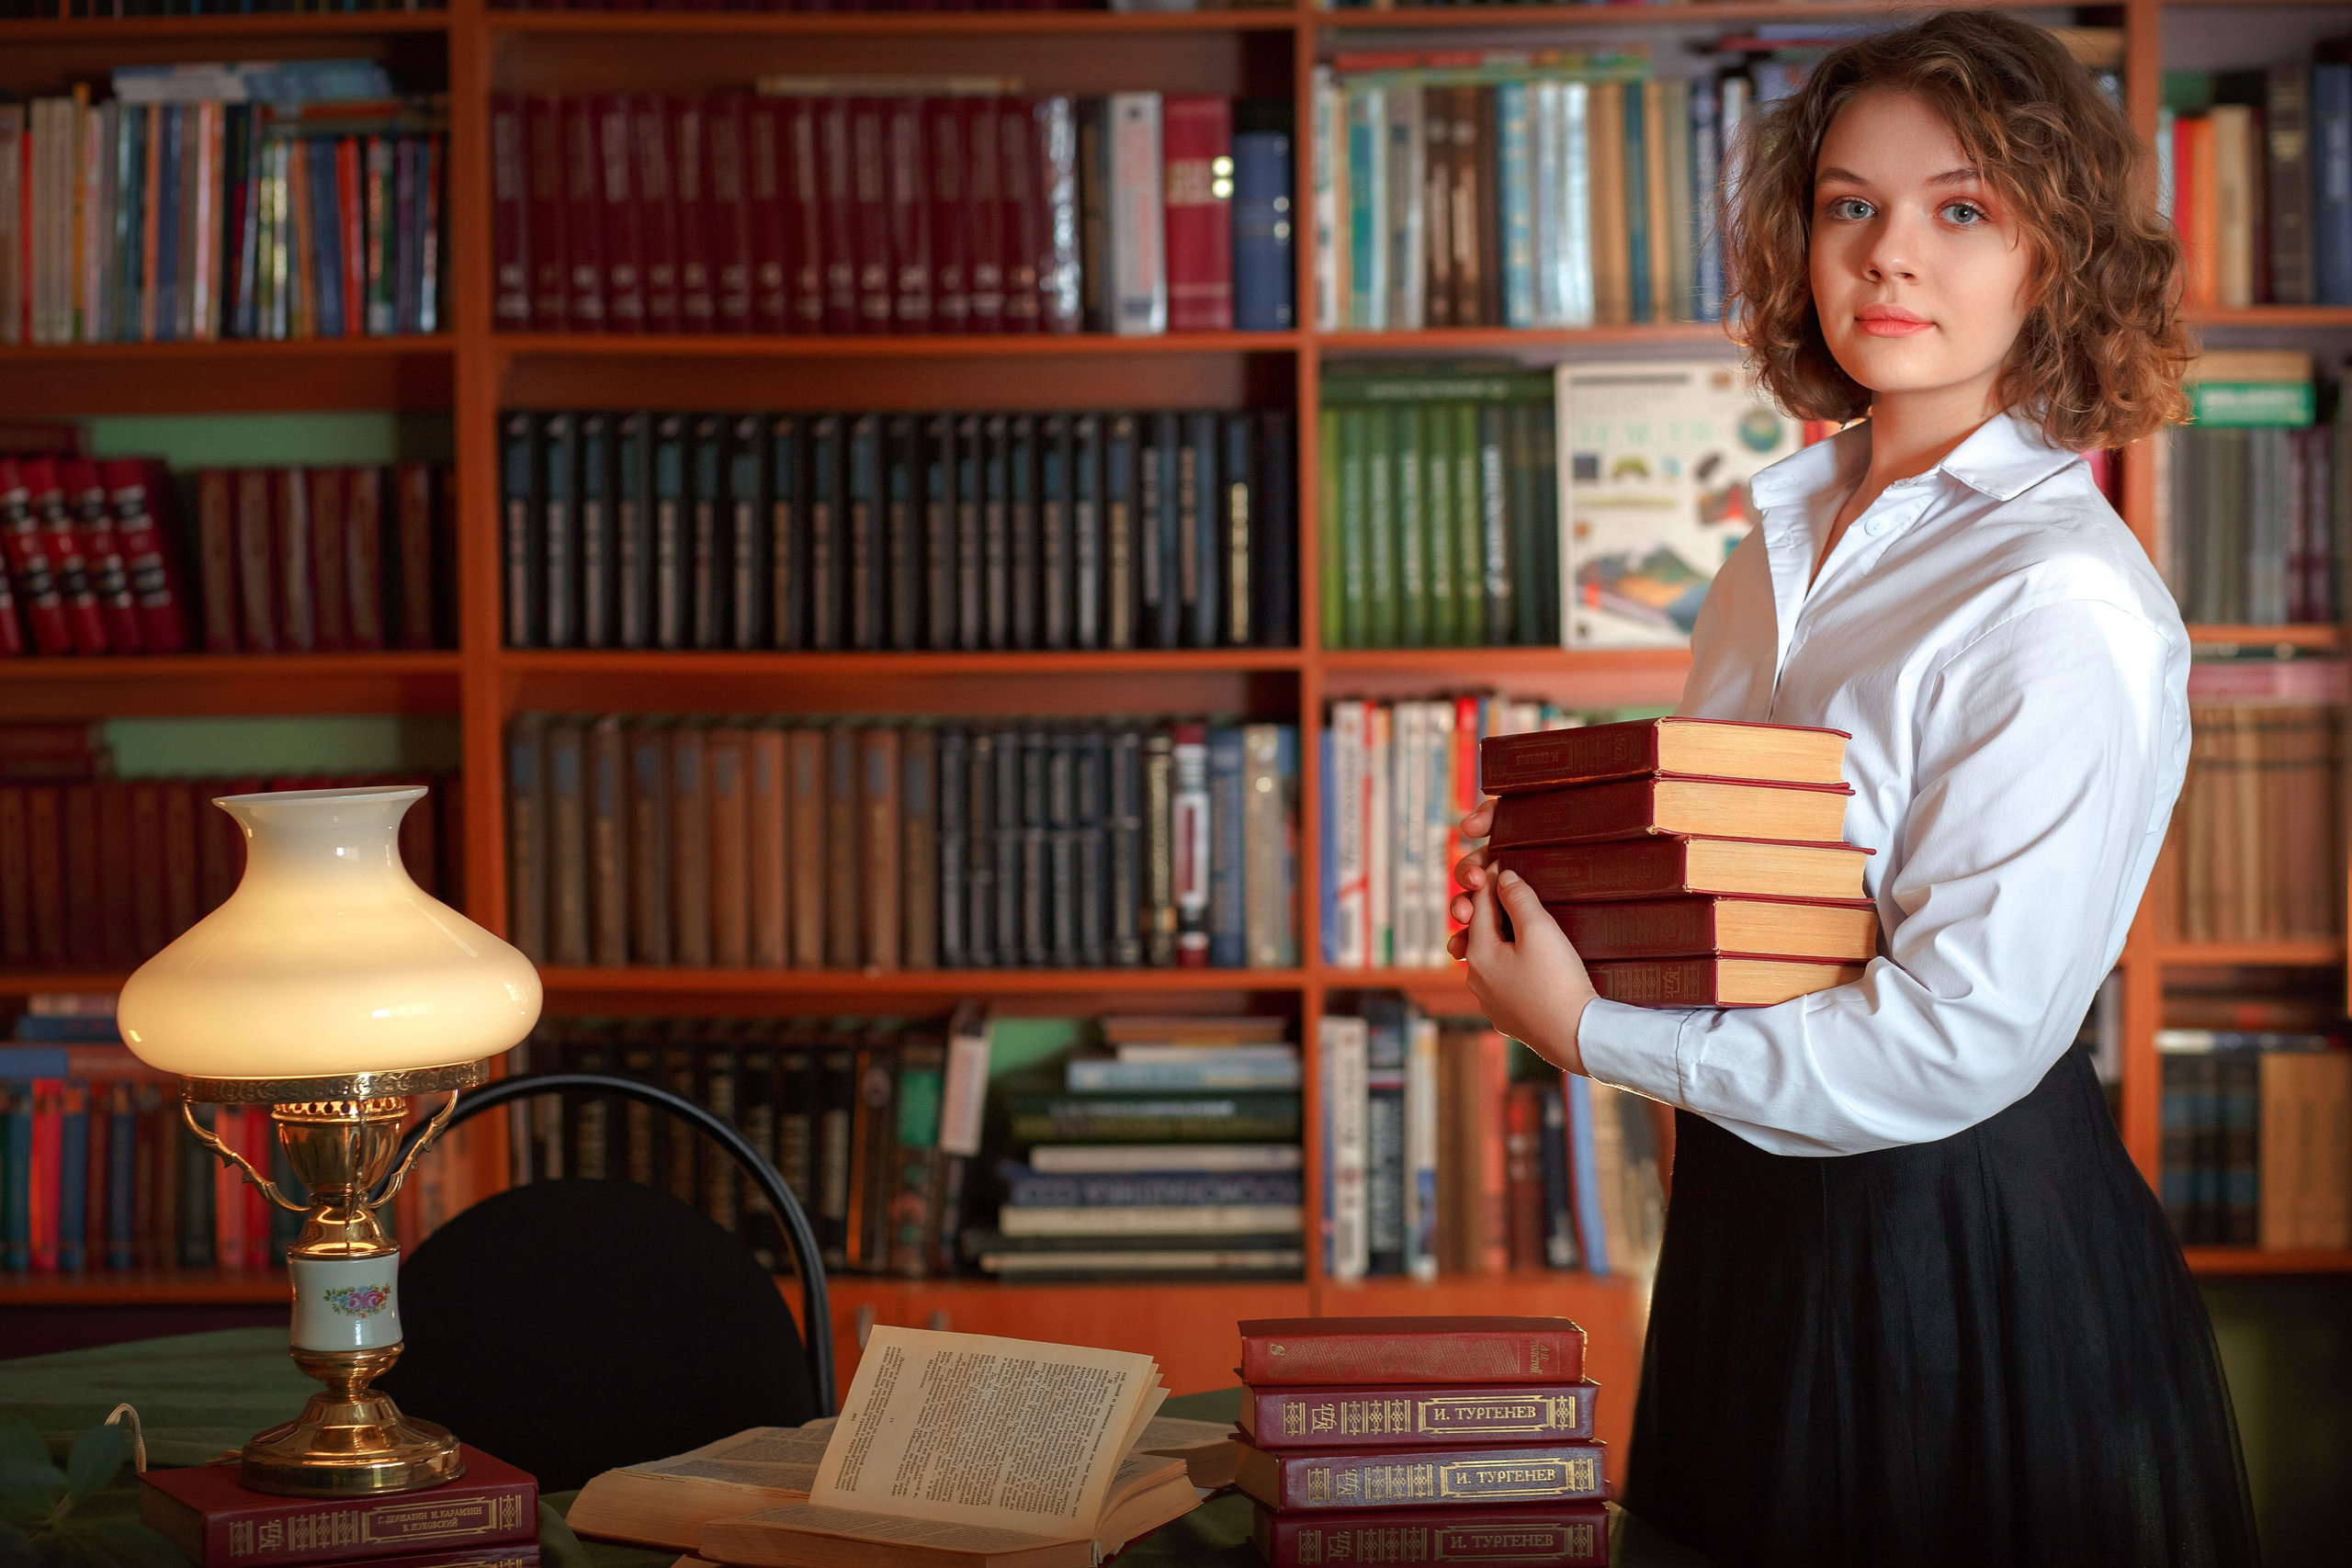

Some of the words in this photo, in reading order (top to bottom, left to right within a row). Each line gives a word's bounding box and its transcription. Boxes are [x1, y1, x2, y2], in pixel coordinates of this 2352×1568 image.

[1434, 1408, 1450, 1420] И.
[1455, 1406, 1537, 1420] ТУРГЕНЕВ
[1456, 1472, 1472, 1484] И.
[1476, 1469, 1556, 1483] ТУРГЕНЕВ
[386, 1511, 427, 1524] ДЕРЖАВИН
[440, 1506, 482, 1518] КАРАМЗИН
[411, 1517, 458, 1531] ЖУКОВСКИЙ
[1451, 1536, 1467, 1548] И.
[1472, 1534, 1554, 1548] ТУРГЕНЕВ
